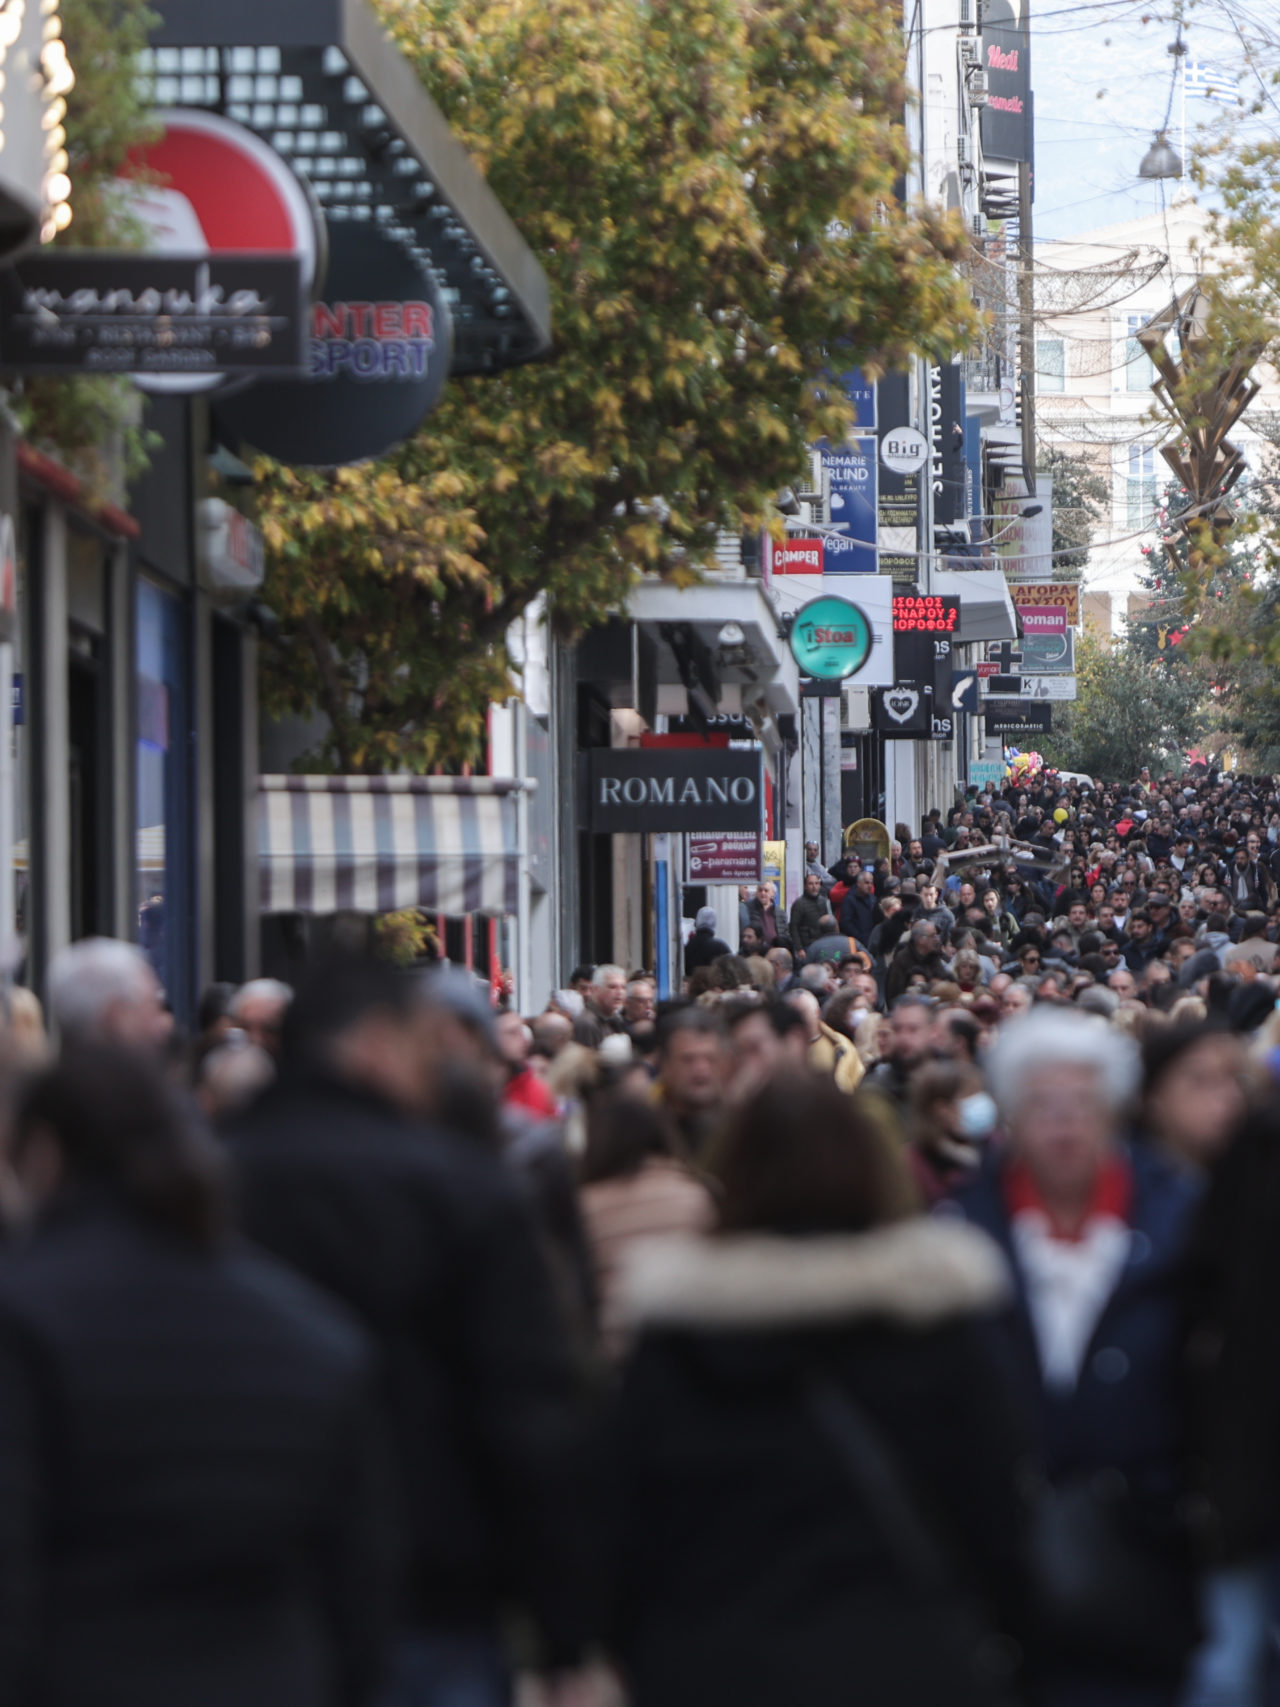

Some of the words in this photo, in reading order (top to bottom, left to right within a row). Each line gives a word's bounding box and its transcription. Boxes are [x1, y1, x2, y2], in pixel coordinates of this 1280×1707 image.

[987, 45, 1019, 71] Medi
[310, 301, 431, 338] NTER
[930, 366, 944, 494] SEPHORA
[888, 441, 922, 457] Big
[775, 551, 820, 567] CAMPER
[1016, 585, 1070, 596] ΑΓΟΡΑ
[948, 608, 957, 619] 2
[600, 776, 757, 804] ROMANO
